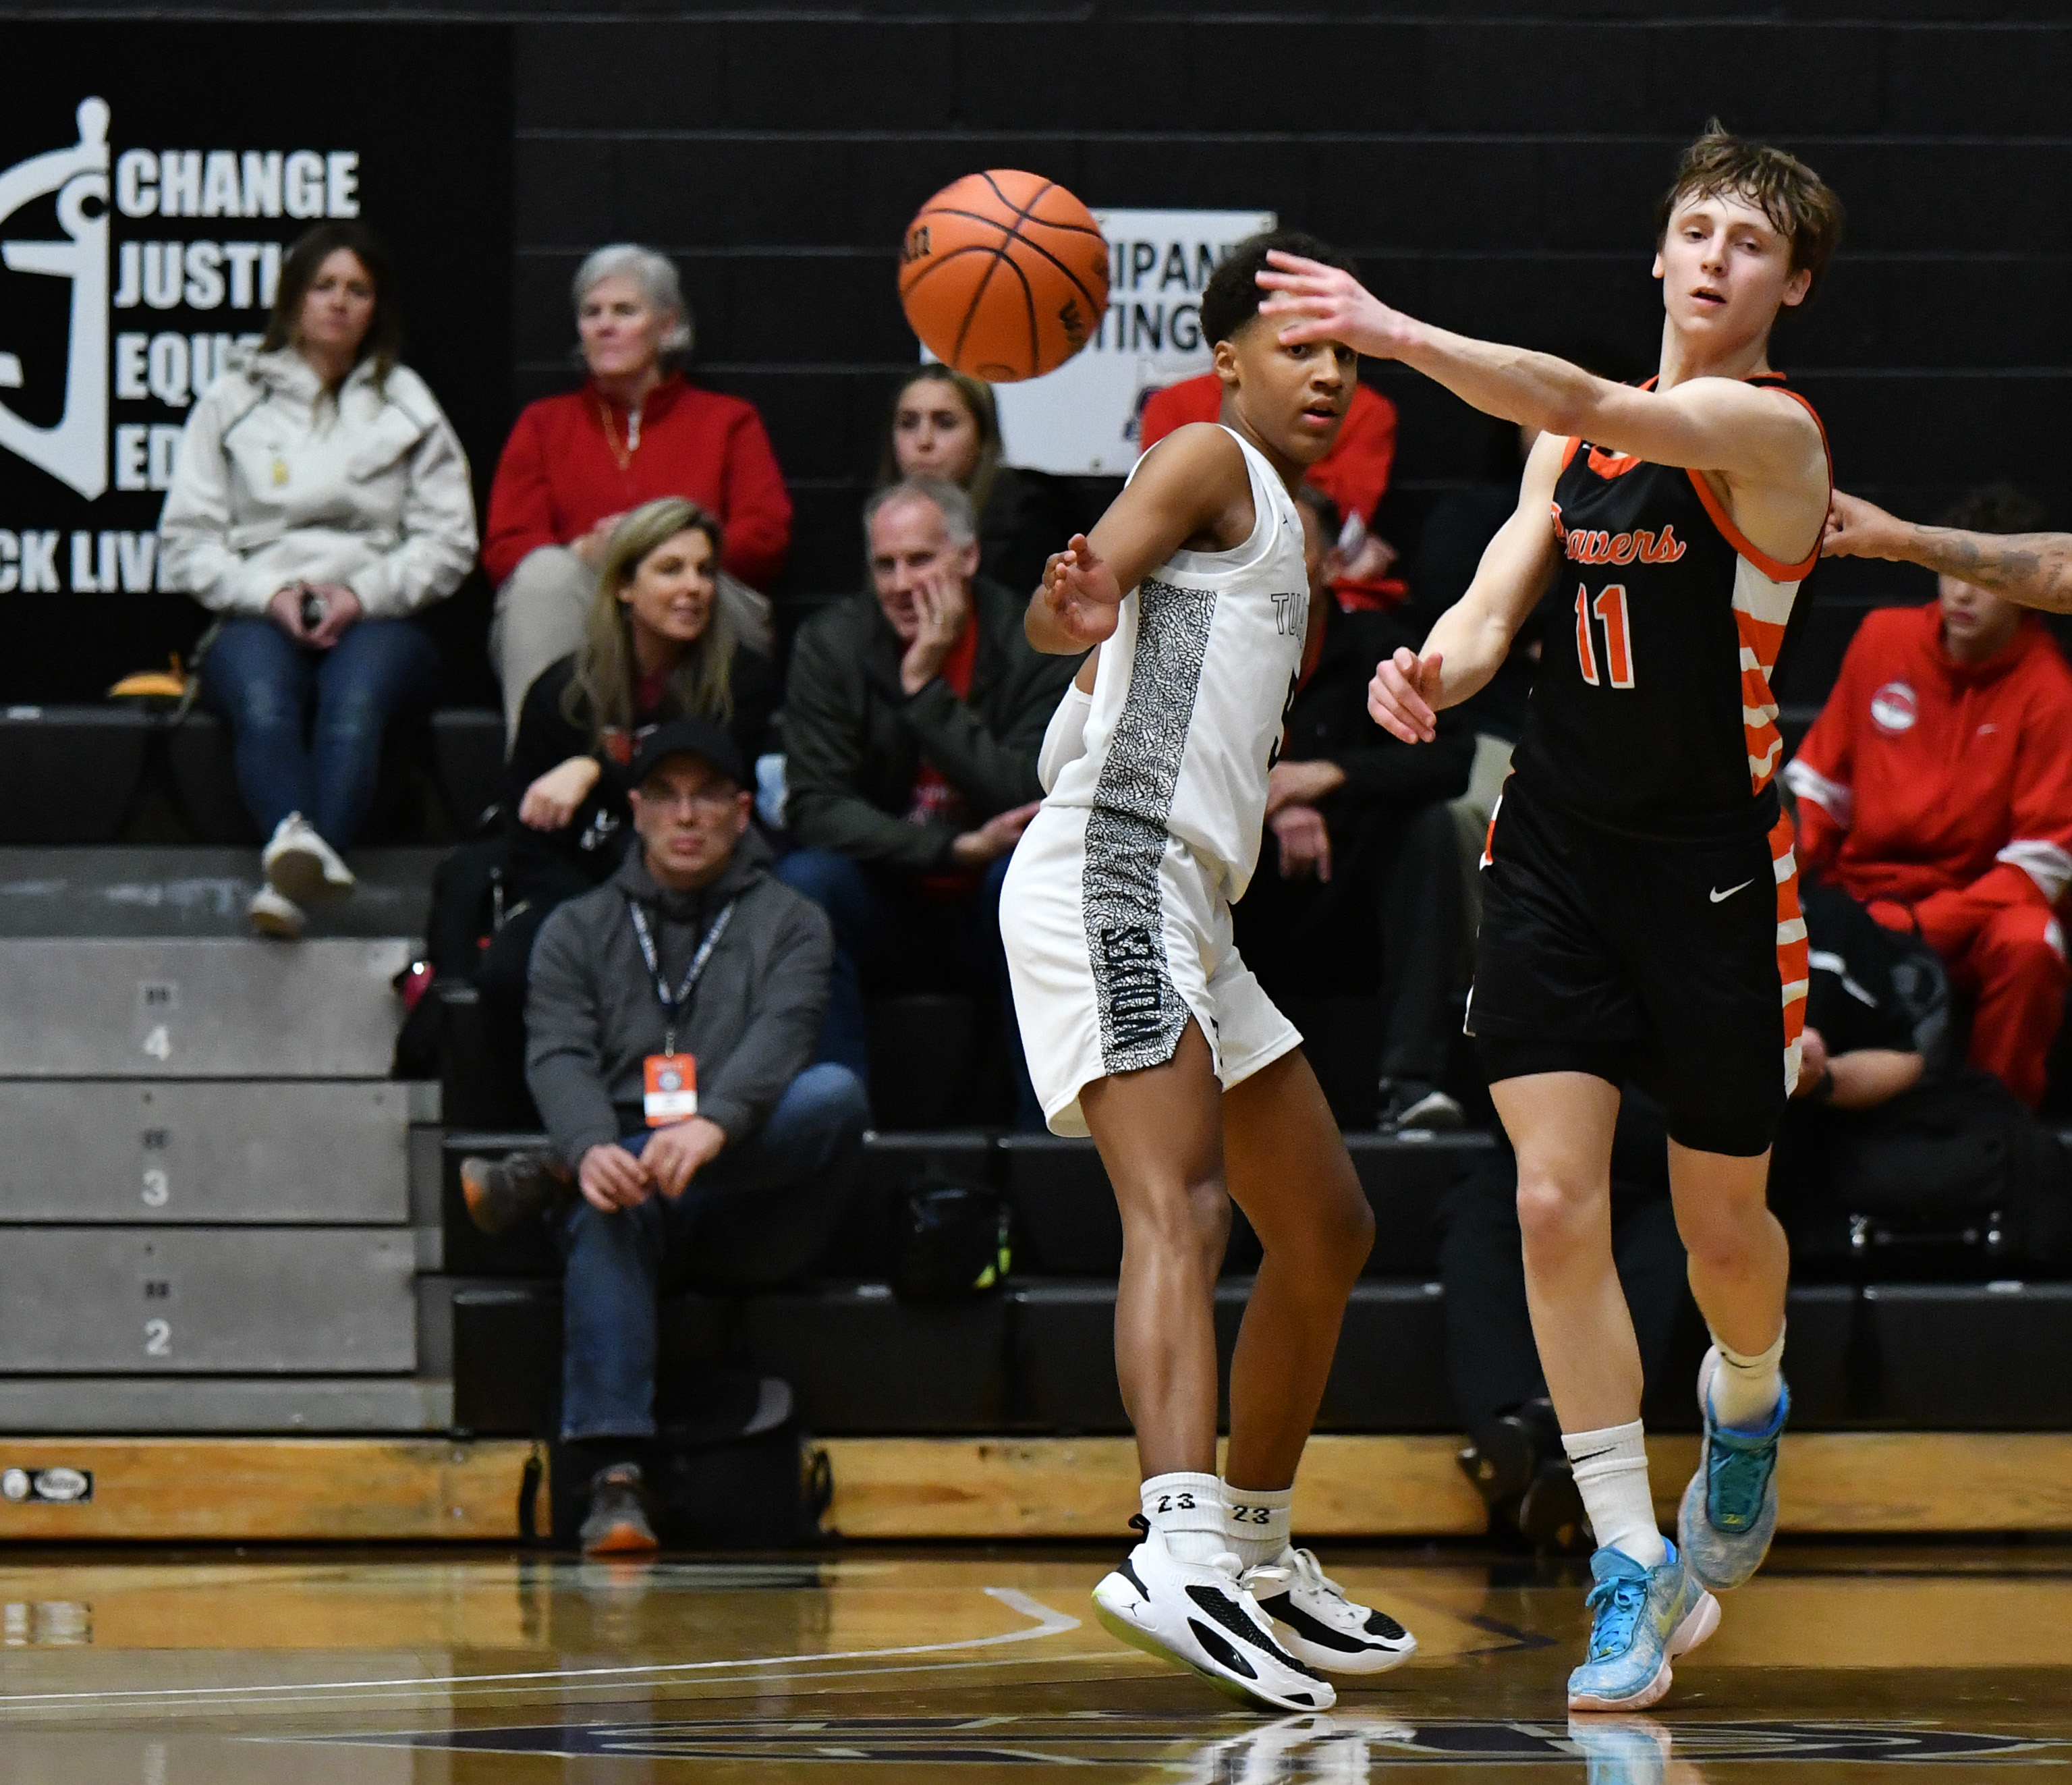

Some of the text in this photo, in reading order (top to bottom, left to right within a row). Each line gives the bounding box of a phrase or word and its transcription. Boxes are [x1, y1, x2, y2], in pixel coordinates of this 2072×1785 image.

[116, 148, 360, 219] CHANGE
[113, 240, 289, 310] JUSTI
[115, 331, 262, 408] EQU
[1551, 501, 1687, 566] avers
[1575, 581, 1635, 689] 11
[1100, 927, 1162, 1050] WOLVES
[144, 1025, 170, 1062] 4
[142, 1168, 169, 1207] 3
[145, 1318, 171, 1355] 2
[1157, 1492, 1196, 1514] 23
[1232, 1505, 1270, 1525] 23
